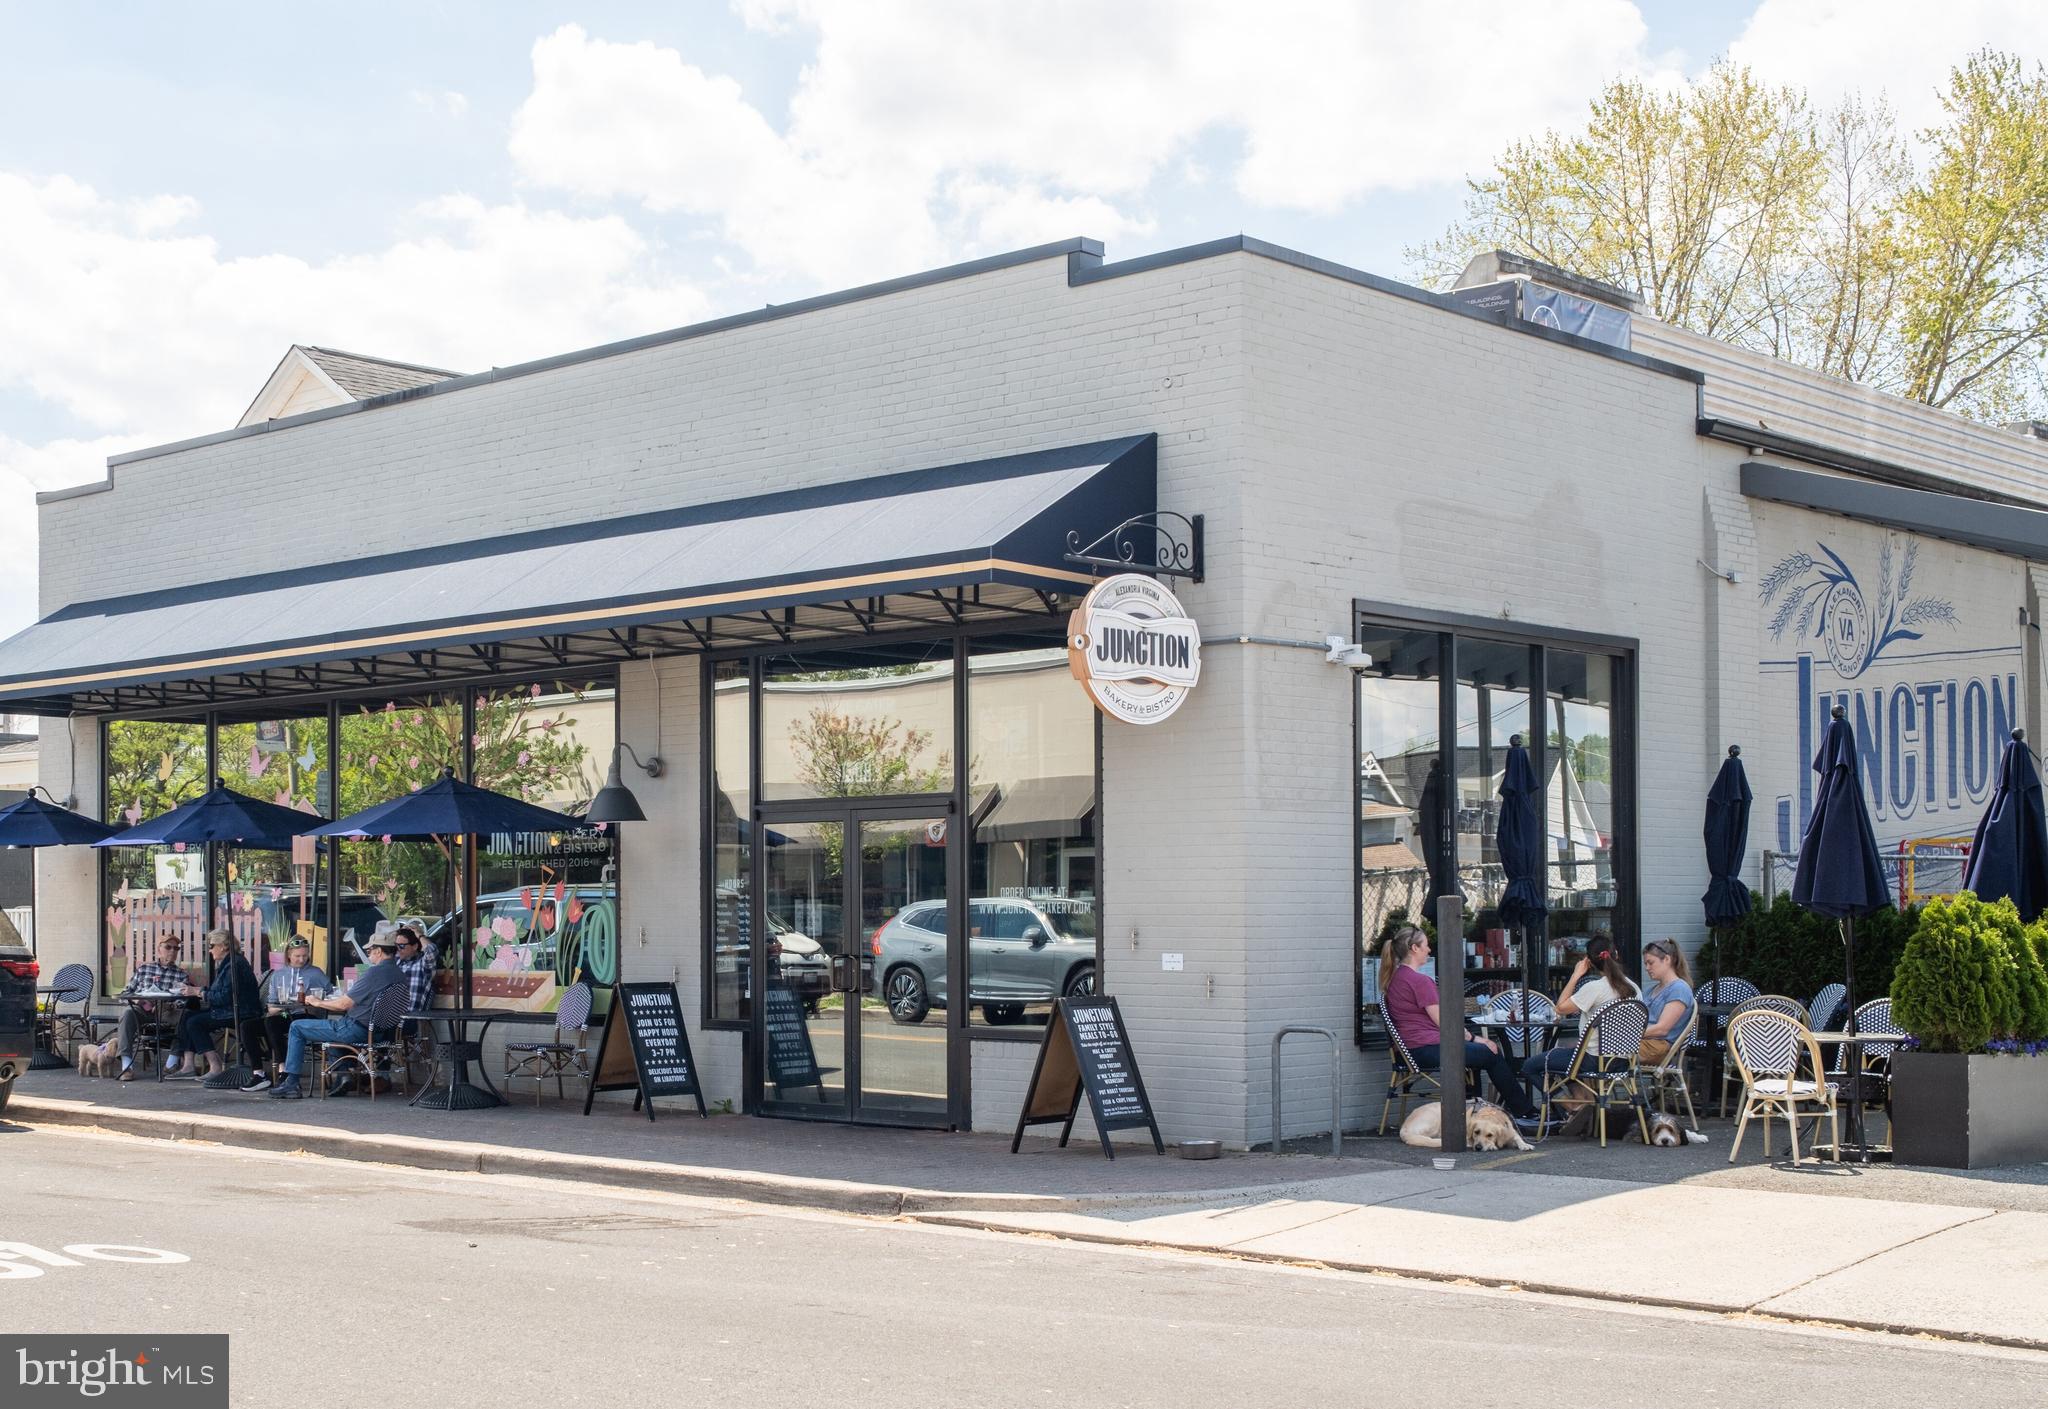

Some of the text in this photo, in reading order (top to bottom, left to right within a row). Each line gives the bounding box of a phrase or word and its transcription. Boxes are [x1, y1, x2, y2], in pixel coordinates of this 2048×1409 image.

[1115, 584, 1160, 602] ALEXANDRIA VIRGINIA
[1828, 587, 1864, 624] ALEXANDRIA
[1839, 617, 1855, 642] VA
[1096, 627, 1190, 669] JUNCTION
[1827, 638, 1866, 674] ALEXANDRIA
[1103, 686, 1139, 714] BAKERY
[1146, 691, 1175, 714] BISTRO
[486, 831, 553, 856] JUNCTION
[563, 842, 606, 854] BISTRO
[502, 858, 590, 869] ESTABLISHED 2016
[725, 879, 744, 889] HOURS
[1000, 886, 1025, 898] ORDER
[1028, 886, 1054, 899] ONLINE
[979, 902, 1091, 914] WWW.JUNCTNBAKERY.COM
[630, 993, 673, 1007] JUNCTION
[1072, 1007, 1114, 1024] JUNCTION
[637, 1018, 677, 1028] JOIN US FOR
[1078, 1022, 1115, 1032] FAMILY STYLE
[638, 1028, 679, 1038] HAPPY HOUR
[1079, 1030, 1119, 1040] MEALS TO-GO
[645, 1038, 677, 1047] EVERYDAY
[651, 1048, 676, 1057] 3-7 PM
[647, 1066, 687, 1076] DELICIOUS DEALS
[661, 1074, 686, 1083] LIBATIONS
